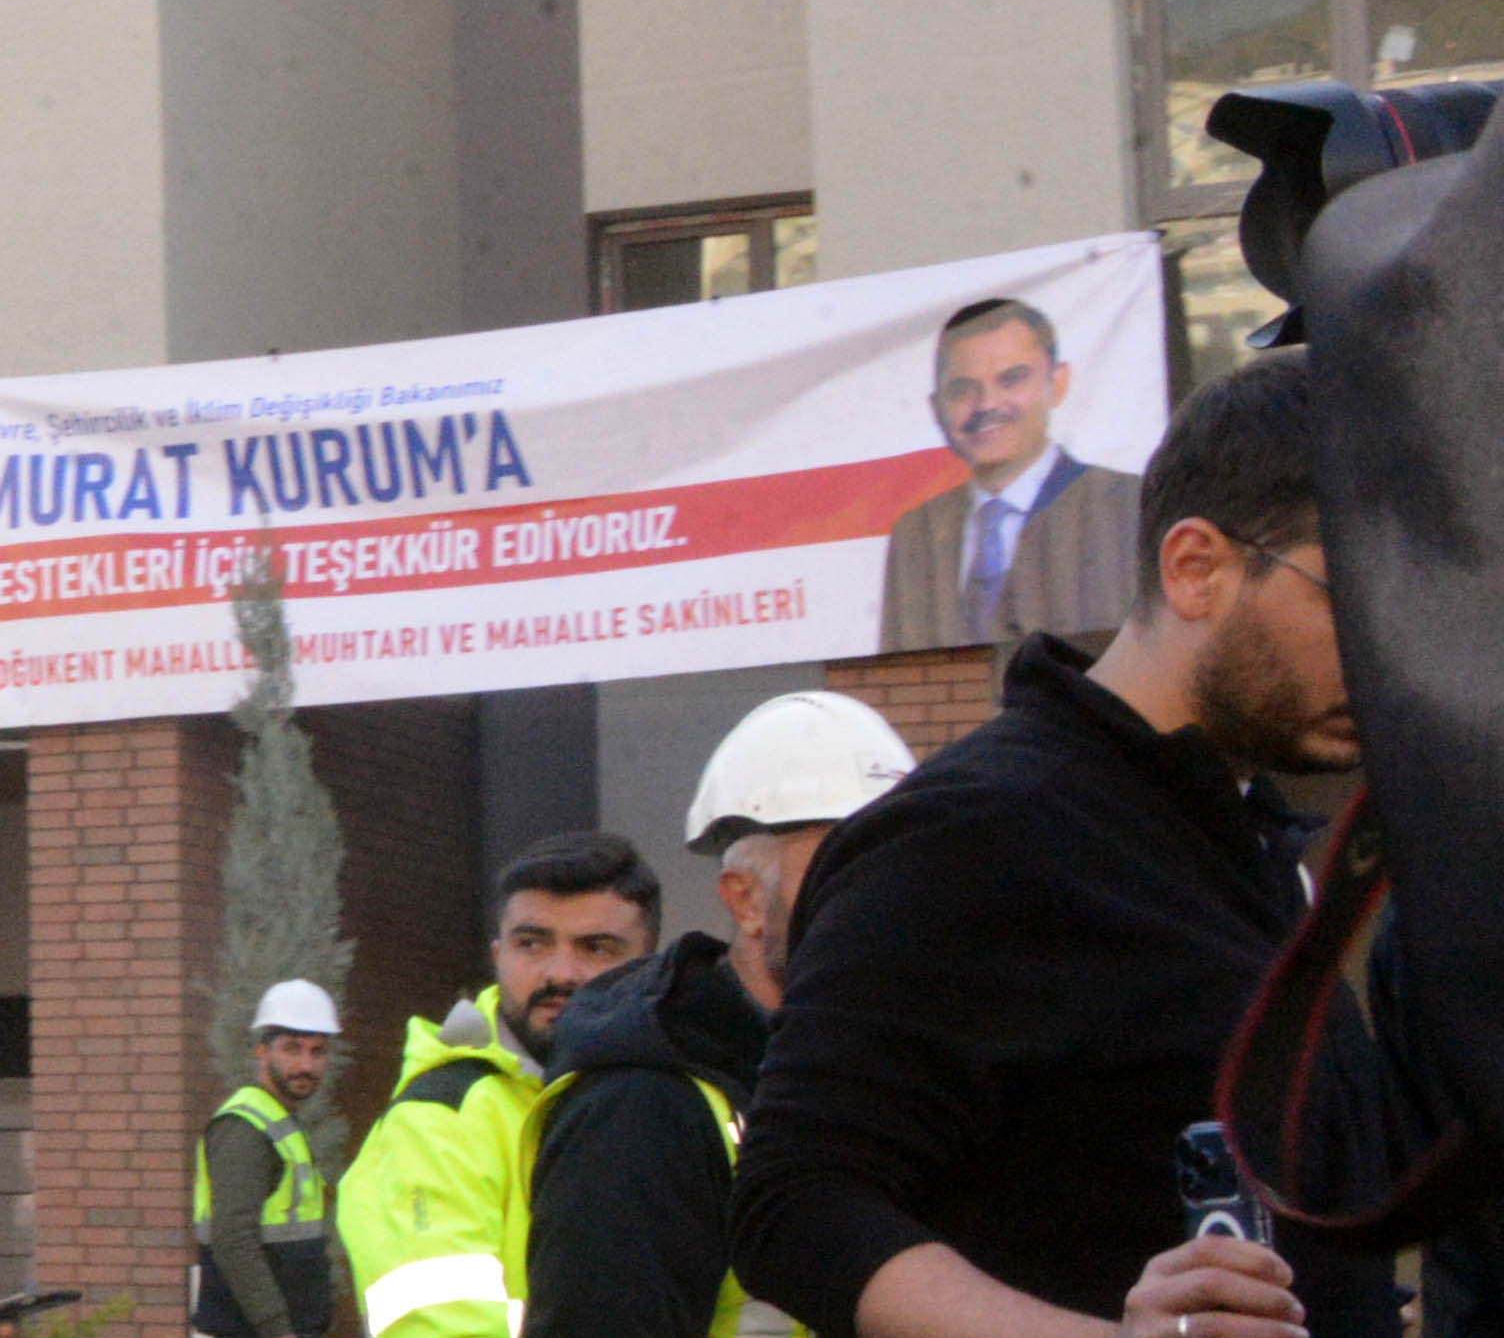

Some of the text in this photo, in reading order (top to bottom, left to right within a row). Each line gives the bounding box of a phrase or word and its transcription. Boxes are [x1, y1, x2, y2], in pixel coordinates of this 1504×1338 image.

[155, 408, 179, 428] ve
[223, 409, 533, 516] KURUM'A
[281, 520, 480, 593] TEŞEKKÜR
[491, 504, 688, 568] EDİYORUZ.
[294, 627, 431, 665] MUHTARI
[440, 622, 474, 655] VE
[486, 606, 628, 652] MAHALLE
[636, 578, 807, 636] SAKİNLERİ
